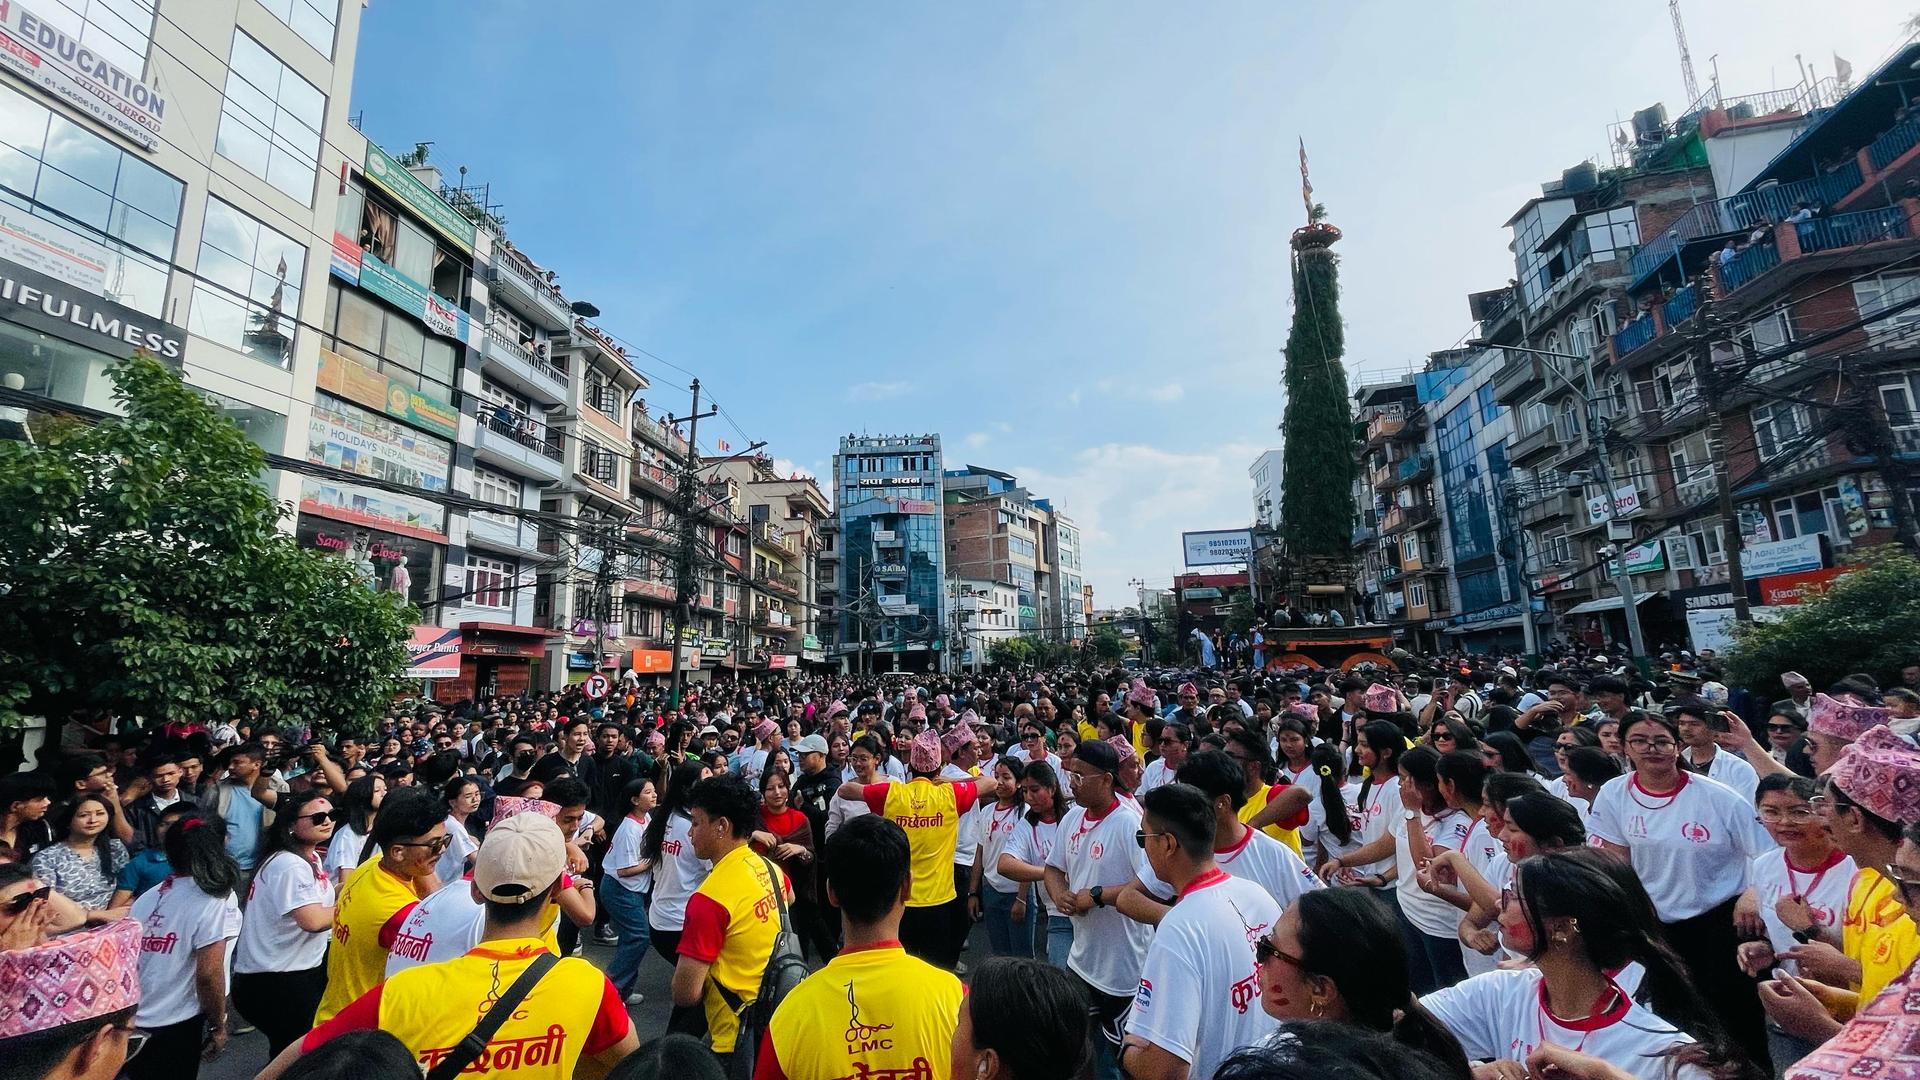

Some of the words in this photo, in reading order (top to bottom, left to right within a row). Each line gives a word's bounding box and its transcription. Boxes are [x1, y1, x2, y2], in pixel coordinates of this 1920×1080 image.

[18, 11, 165, 120] EDUCATION
[74, 75, 115, 106] STUDY
[115, 101, 161, 133] ABROAD
[330, 428, 377, 453] HOLIDAYS
[380, 445, 407, 462] NEPAL
[1602, 492, 1637, 514] Cstrol
[433, 642, 460, 653] Paints
[847, 1039, 893, 1055] LMC
